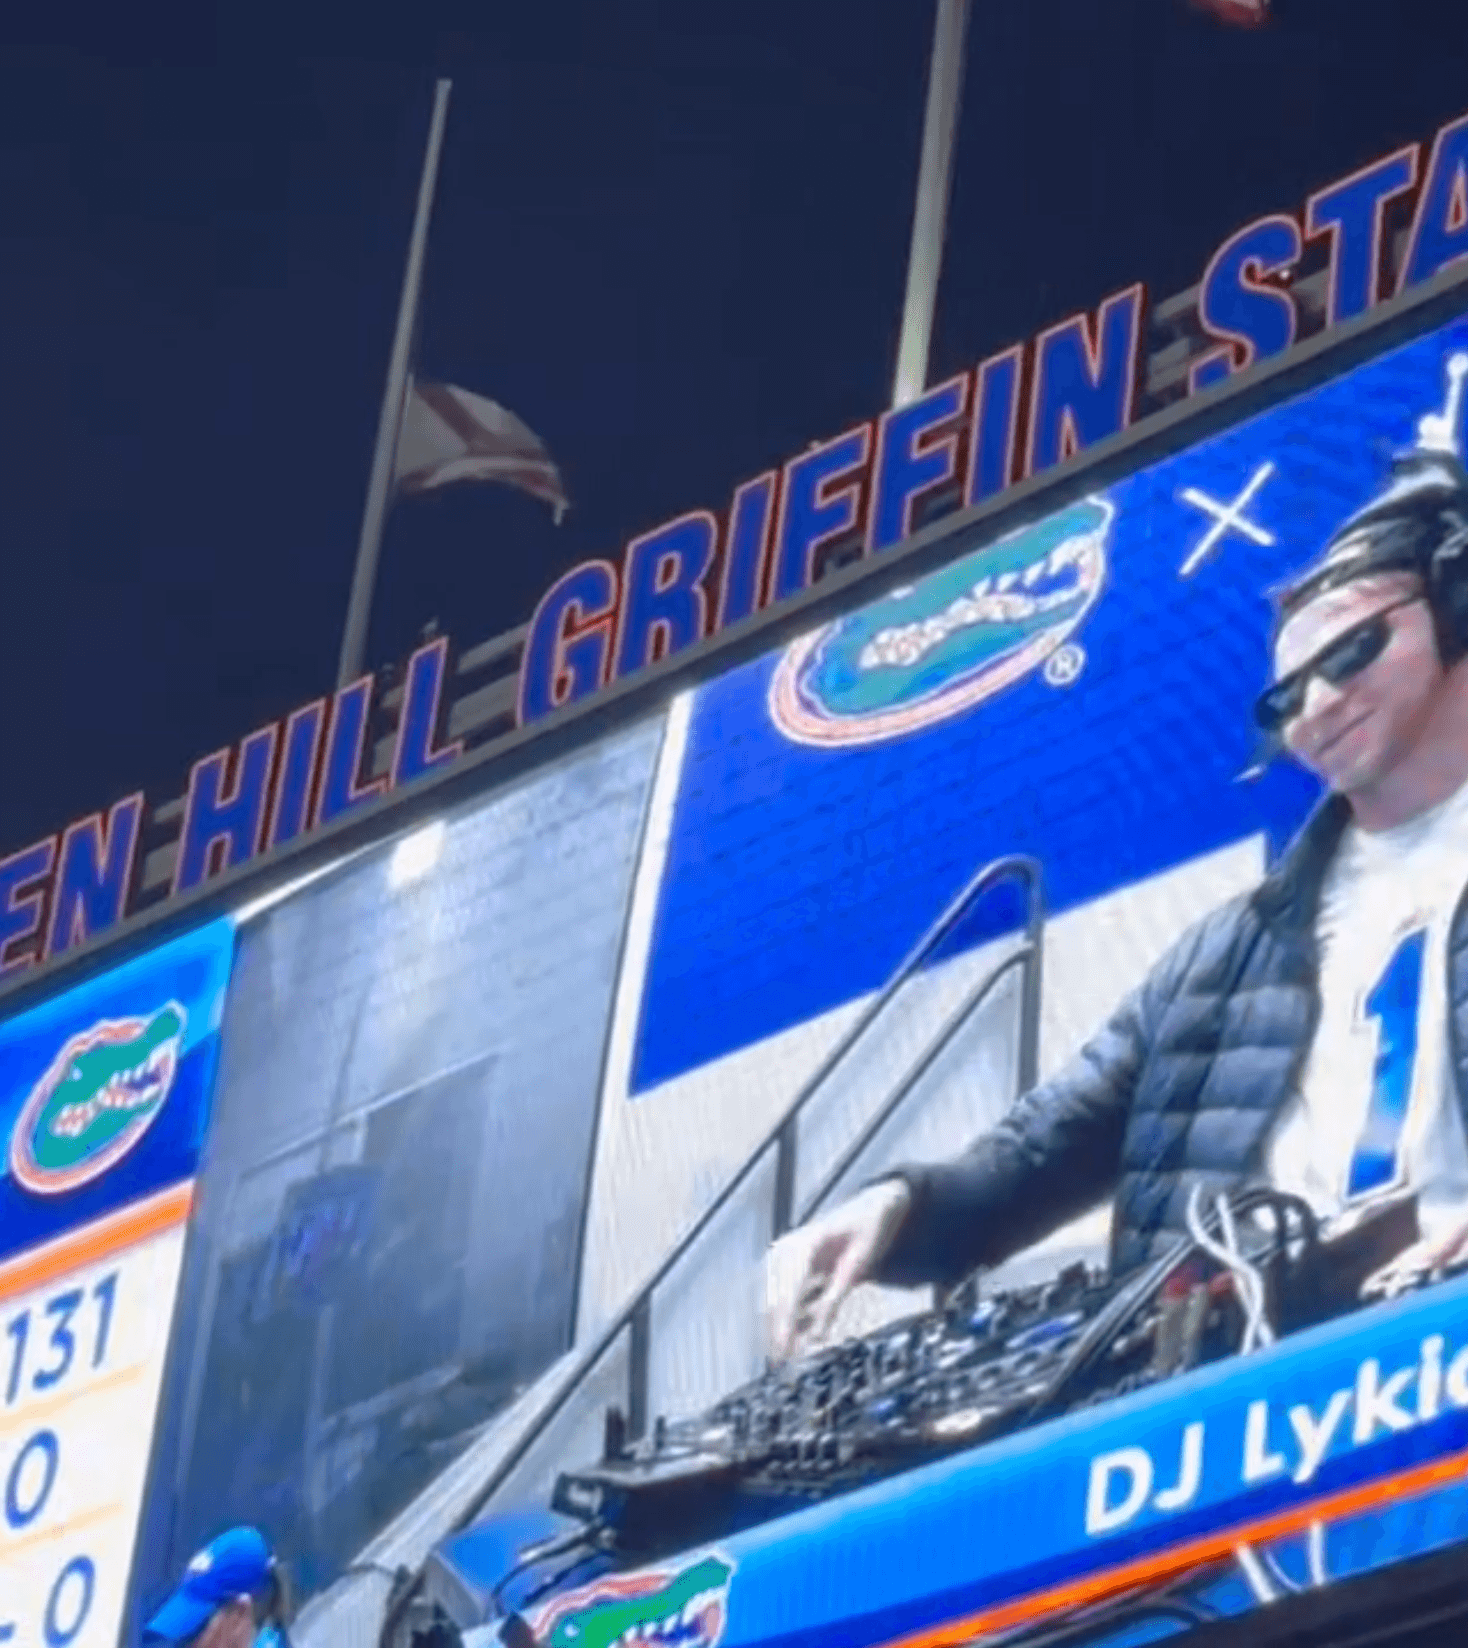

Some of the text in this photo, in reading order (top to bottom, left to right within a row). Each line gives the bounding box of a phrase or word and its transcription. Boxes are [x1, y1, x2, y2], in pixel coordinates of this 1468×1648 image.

[0, 789, 144, 976] EN
[170, 636, 464, 898] HILL
[518, 282, 1143, 730] GRIFFIN
[6, 1269, 120, 1406] 131
[4, 1427, 59, 1532] 0
[1085, 1422, 1205, 1535] DJ
